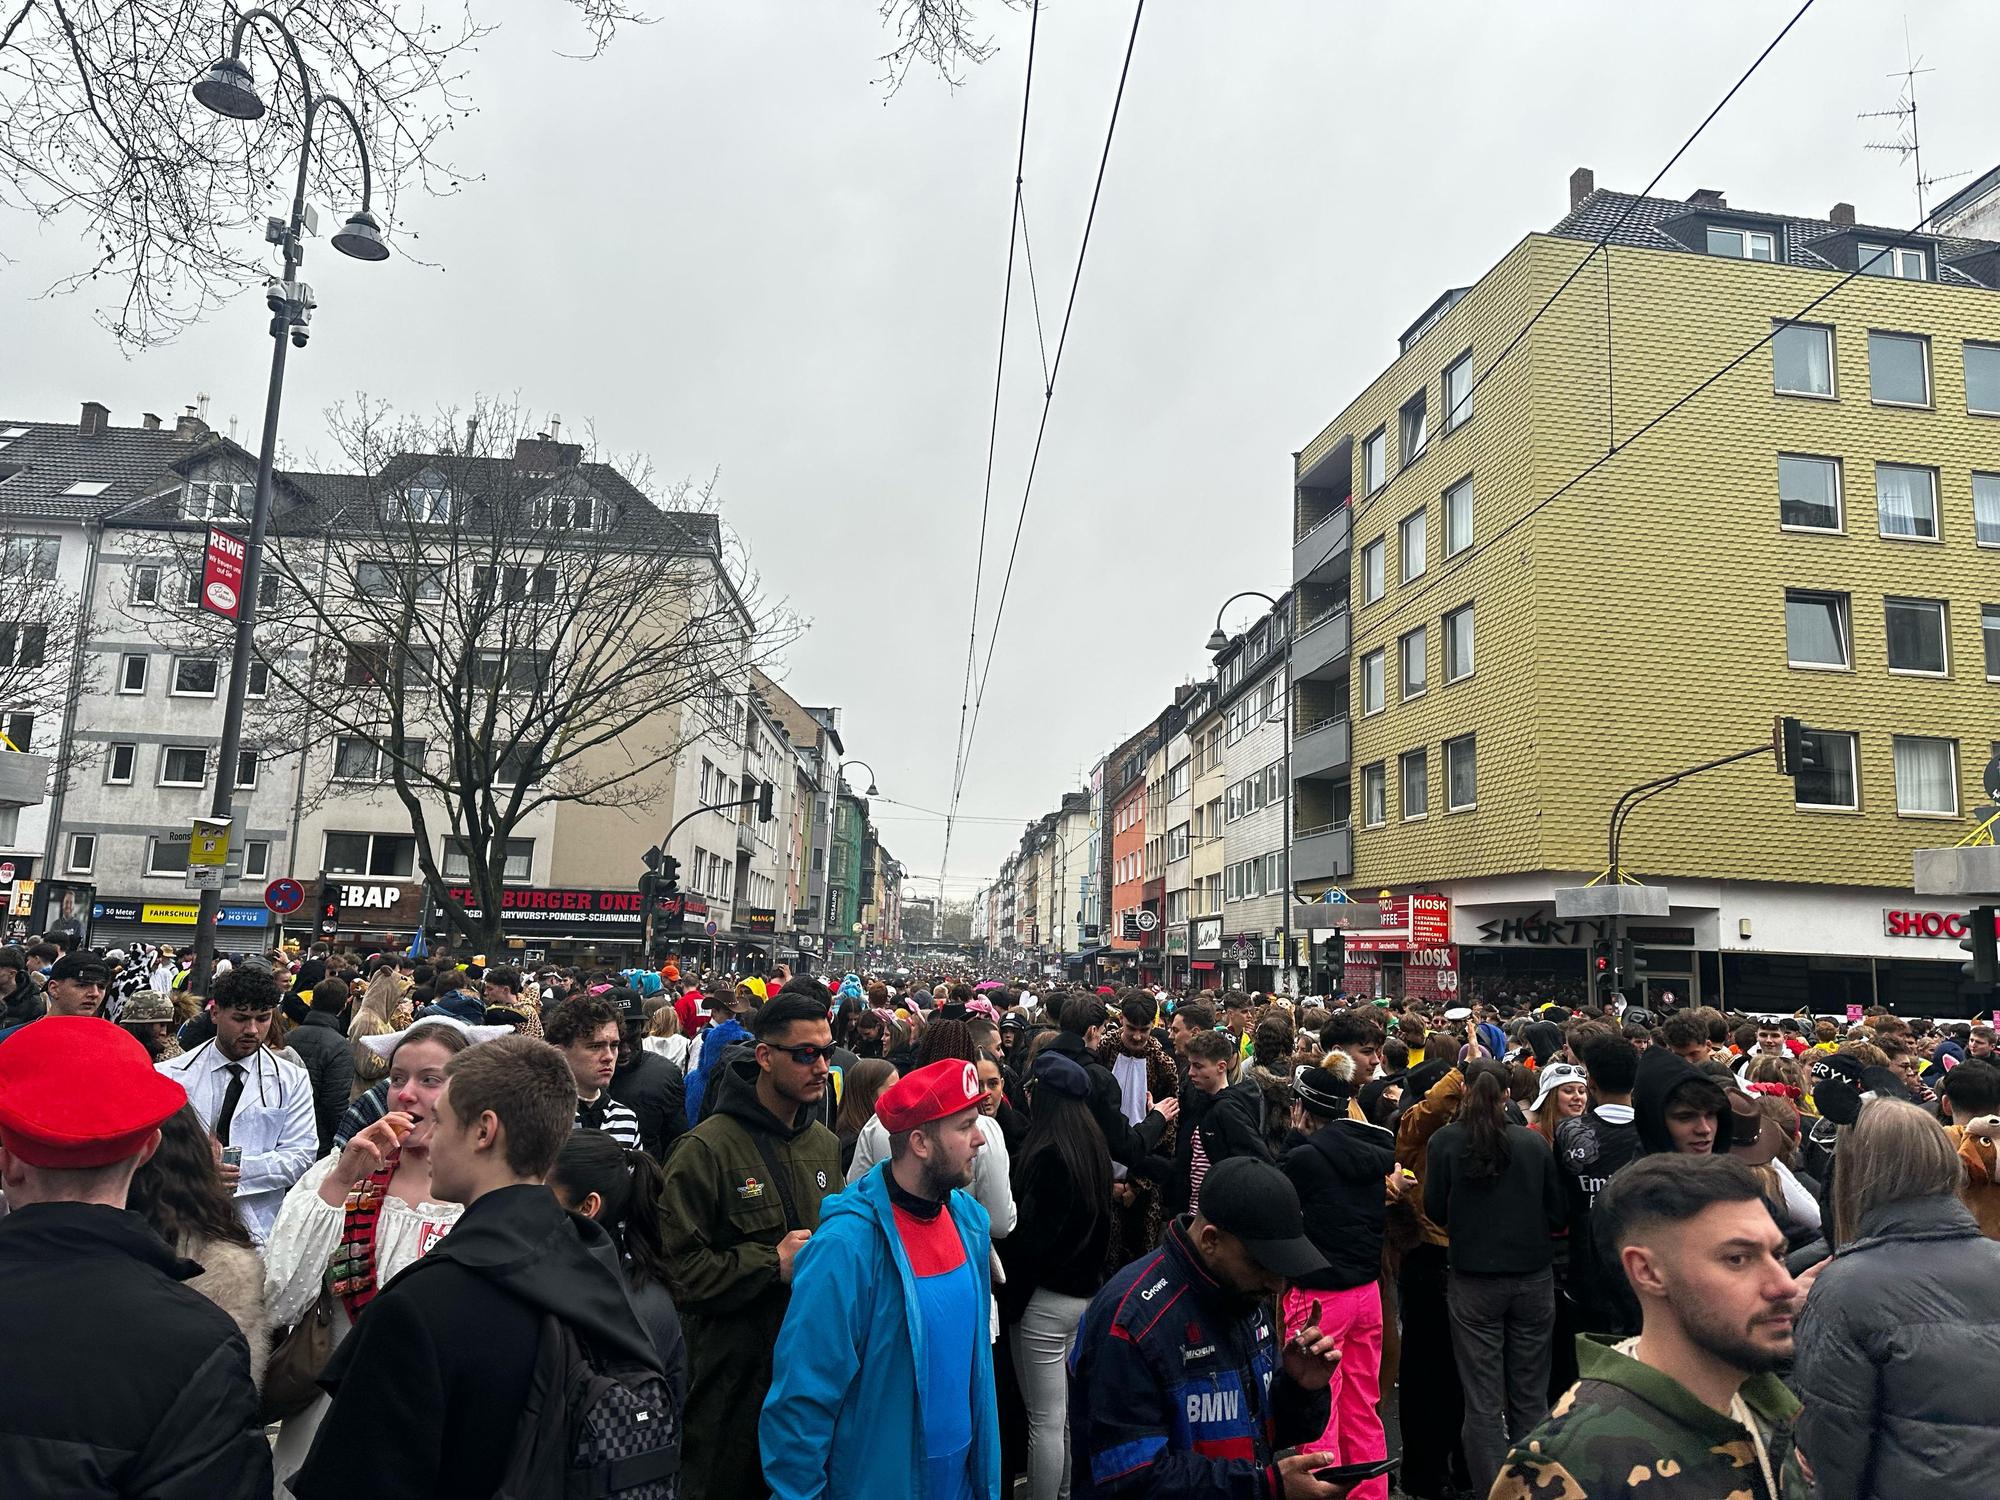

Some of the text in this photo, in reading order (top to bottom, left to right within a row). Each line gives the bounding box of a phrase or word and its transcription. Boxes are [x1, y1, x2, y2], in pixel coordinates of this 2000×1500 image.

[210, 531, 244, 560] REWE
[169, 832, 192, 840] Roons
[501, 891, 592, 910] BURGER
[600, 893, 643, 910] ONE
[1414, 898, 1447, 910] KIOSK
[150, 910, 198, 918] FAHRSCHULE
[1888, 911, 1967, 938] SHOC
[1410, 949, 1451, 966] KIOSK
[1568, 1148, 1585, 1159] Y-3
[1578, 1175, 1612, 1192] Em
[1187, 1390, 1239, 1423] BMW
